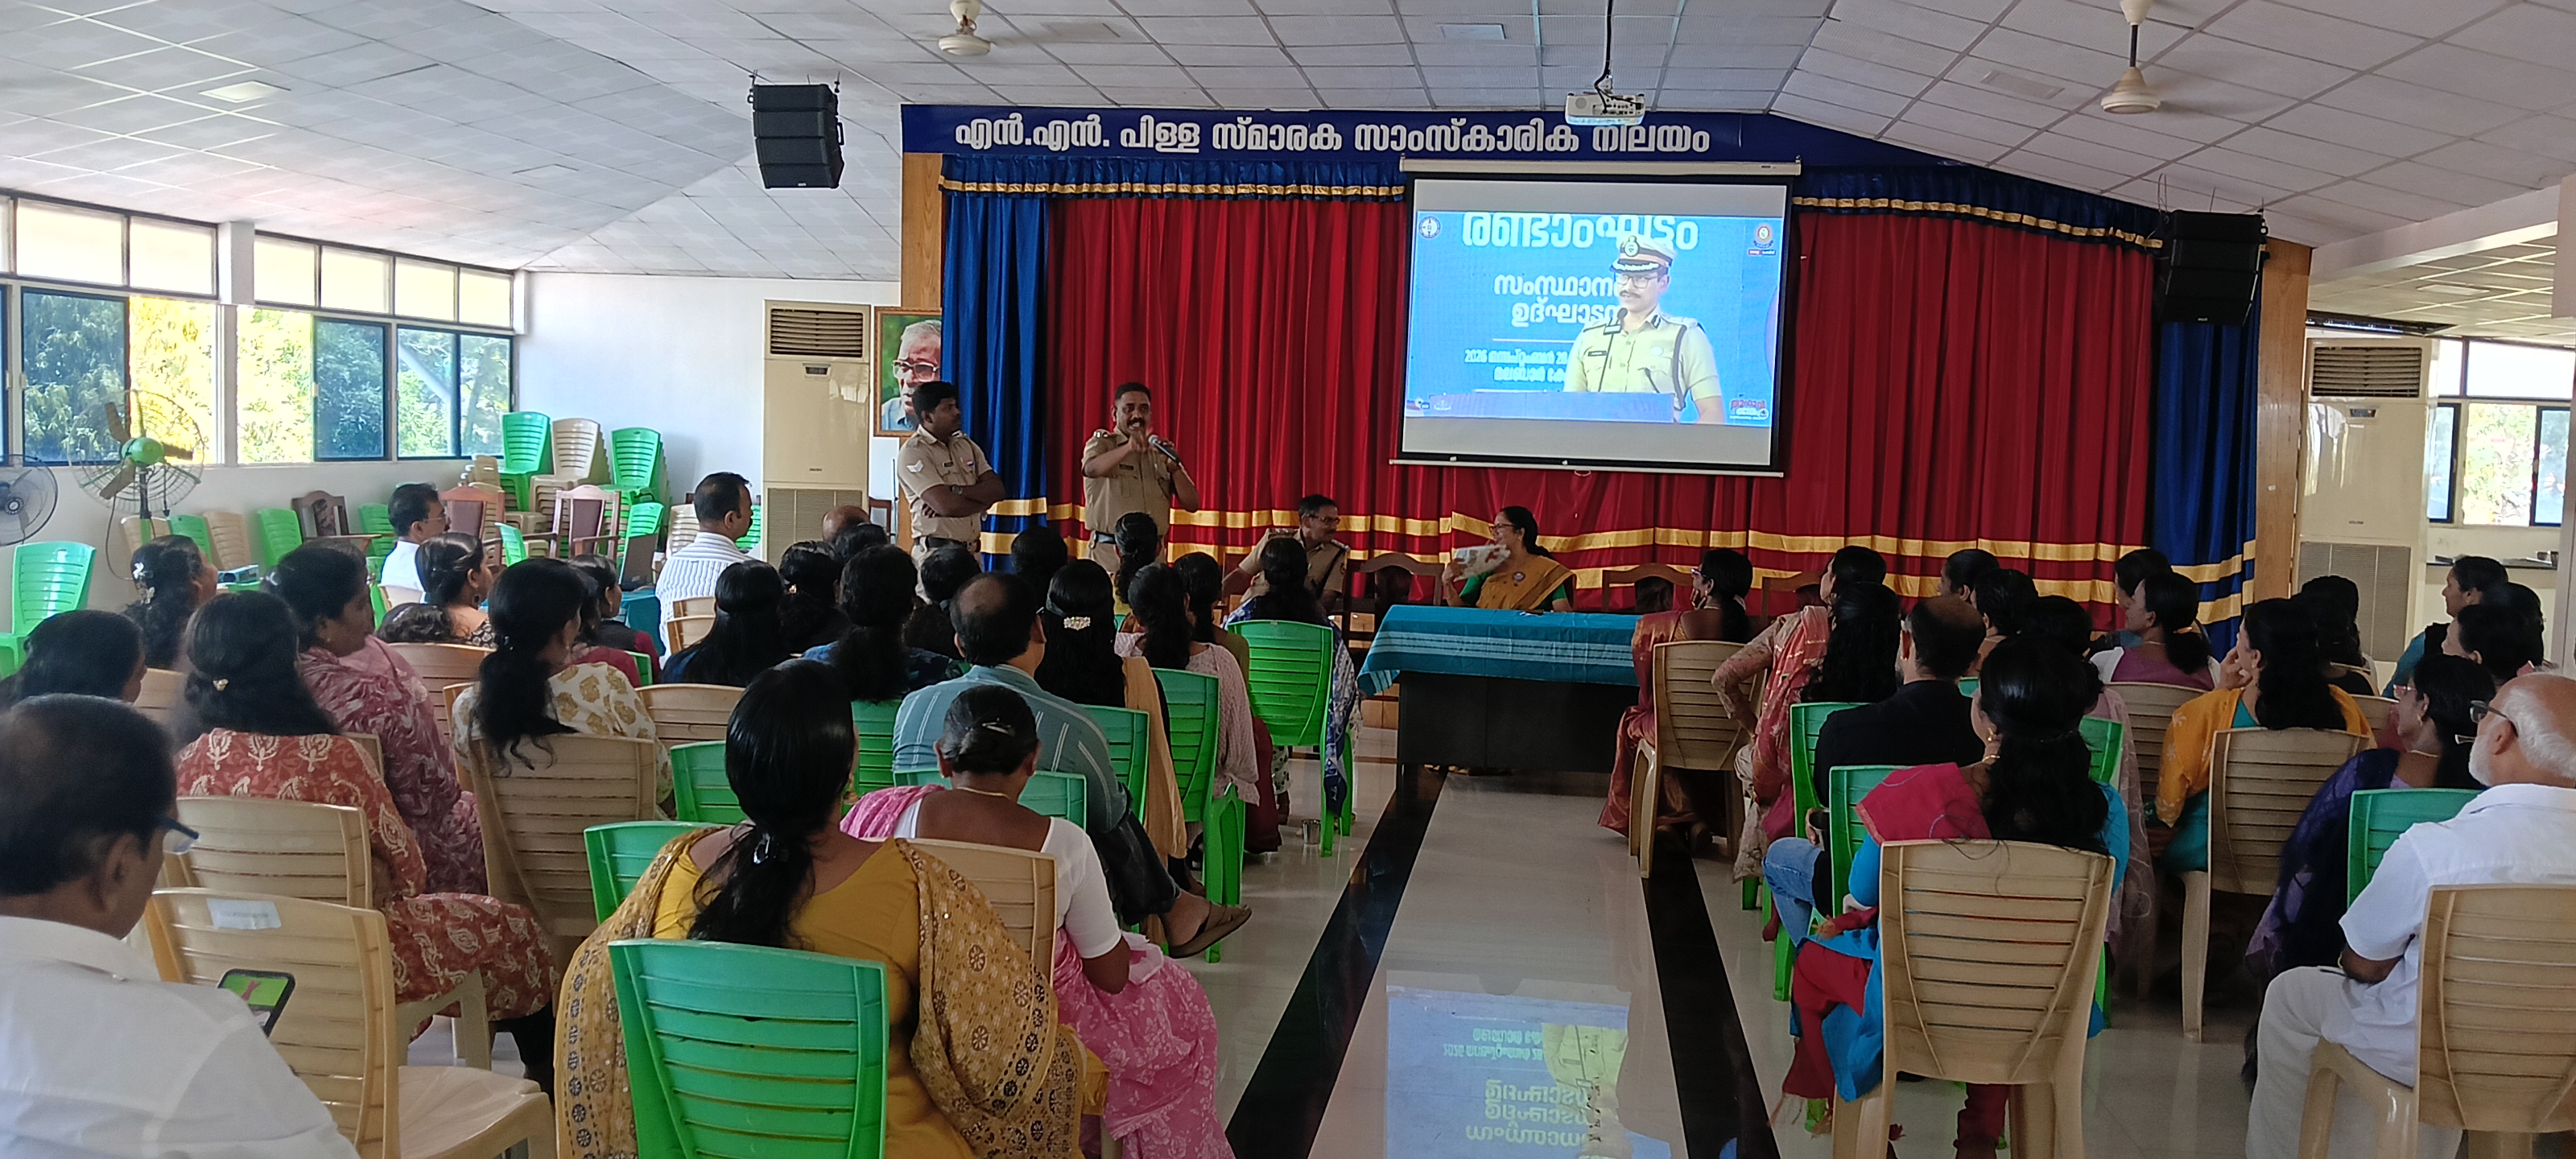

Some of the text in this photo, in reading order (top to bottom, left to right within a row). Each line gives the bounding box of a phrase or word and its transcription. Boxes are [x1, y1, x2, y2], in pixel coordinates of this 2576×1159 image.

[1120, 114, 1201, 153] പിള്ള
[1212, 117, 1343, 151] സ്മാരക
[1354, 118, 1579, 152] സാംസ്കാരിക
[1494, 274, 1618, 297] സംസ്ഥാന
